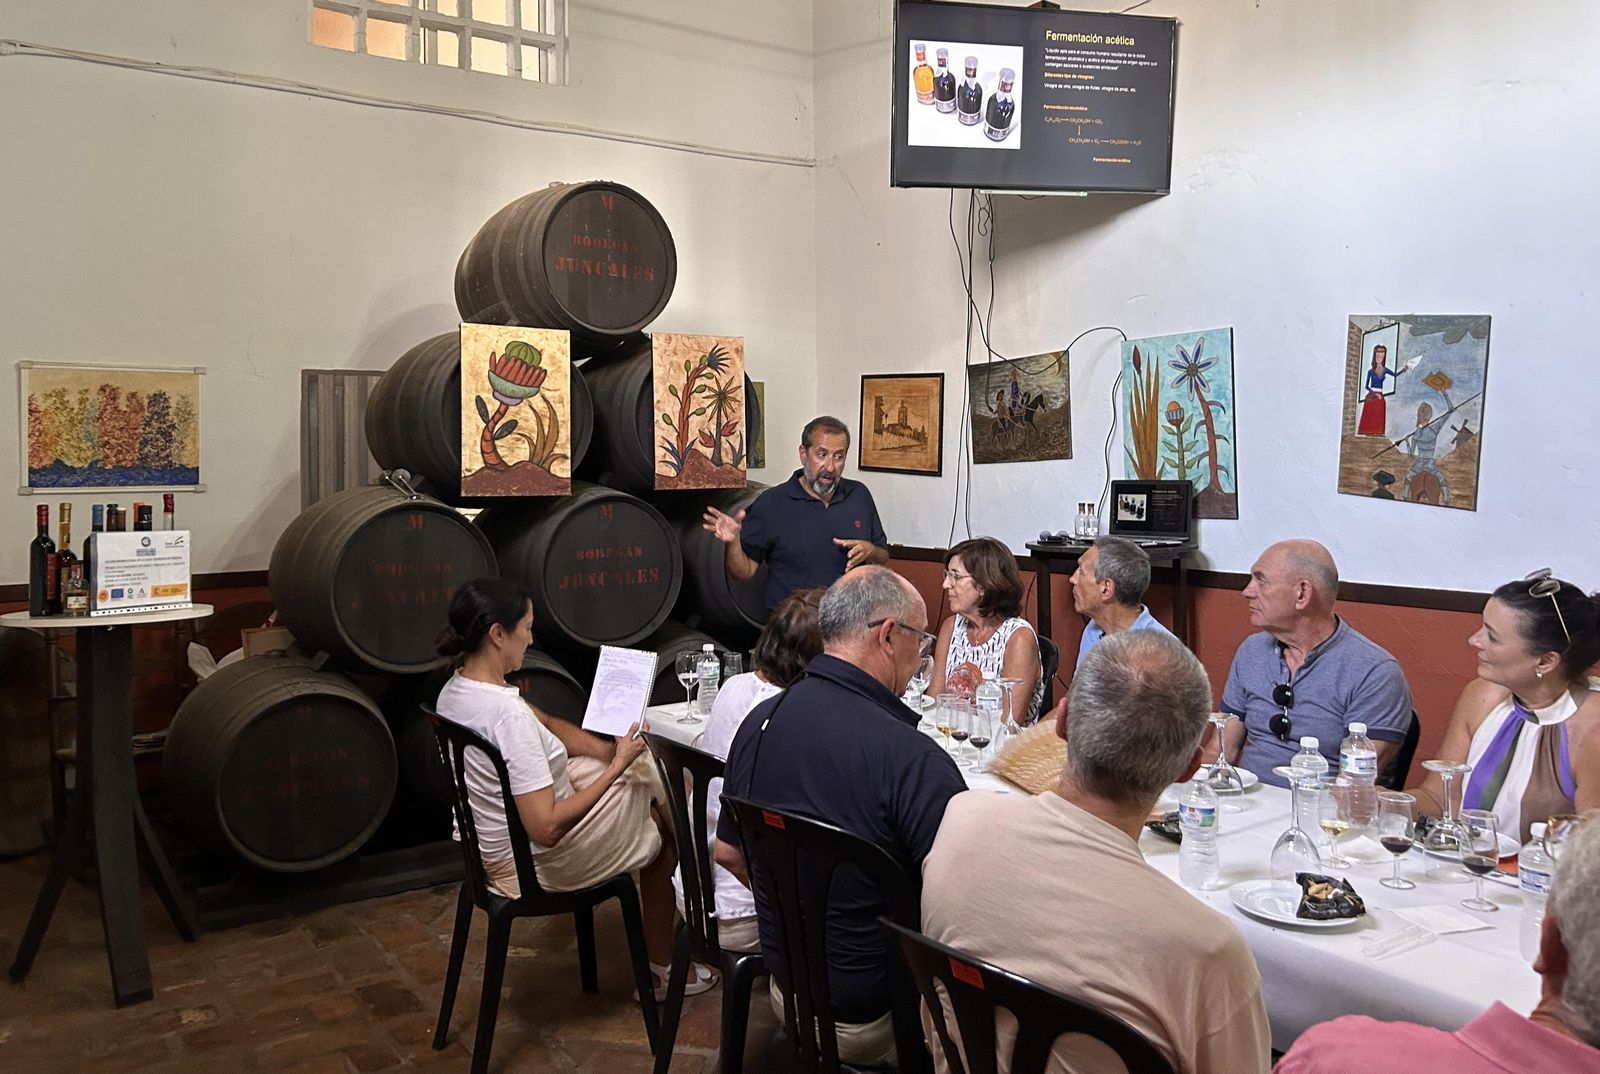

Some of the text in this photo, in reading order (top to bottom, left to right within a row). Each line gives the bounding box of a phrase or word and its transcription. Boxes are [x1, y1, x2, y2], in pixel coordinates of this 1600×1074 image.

[1045, 30, 1135, 46] Fermentación acética
[559, 568, 659, 590] JUNCLES
